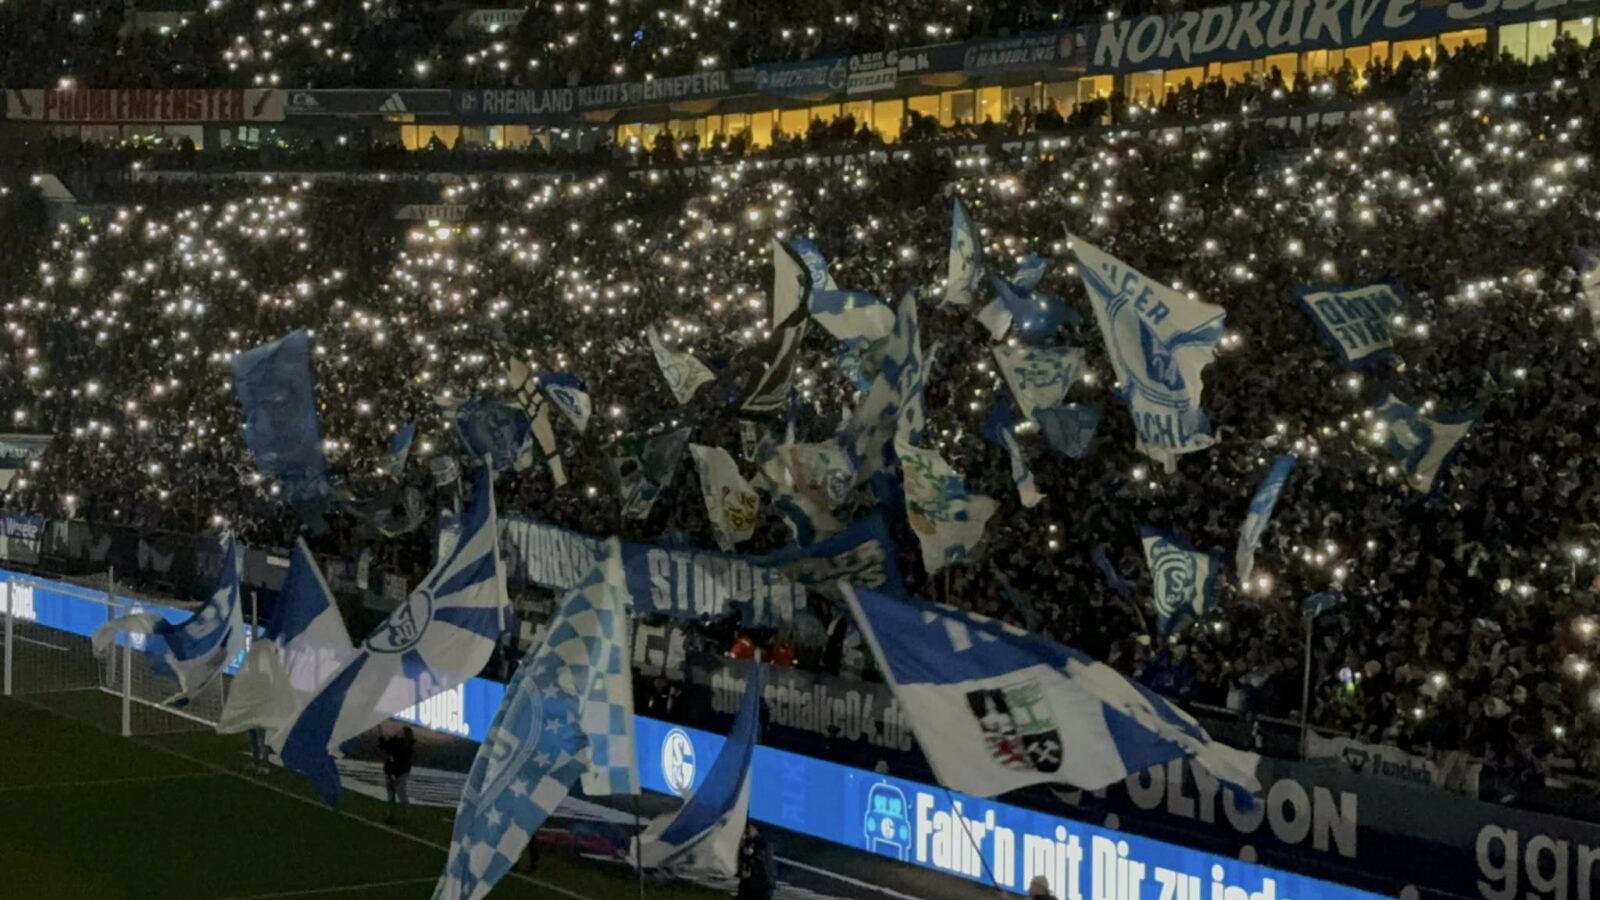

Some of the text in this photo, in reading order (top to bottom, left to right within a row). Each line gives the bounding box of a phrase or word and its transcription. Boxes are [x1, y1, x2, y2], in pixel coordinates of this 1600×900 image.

[482, 88, 573, 114] RHEINLAND
[916, 791, 1015, 887] Fahr'n
[1023, 825, 1084, 900] mit
[1091, 835, 1146, 900] Dir
